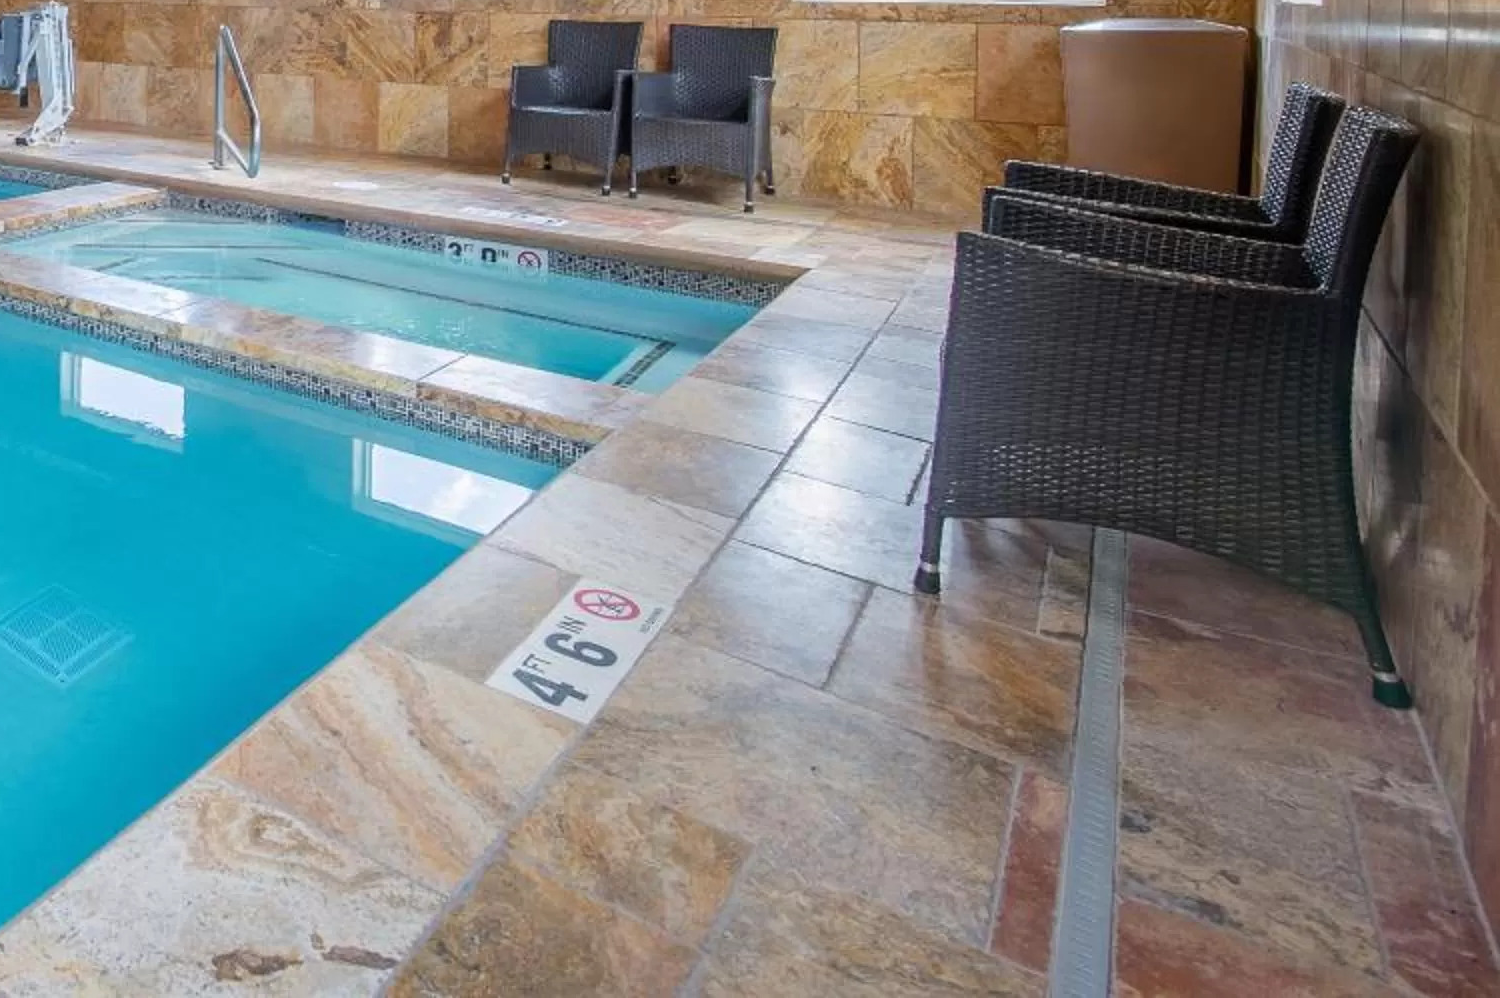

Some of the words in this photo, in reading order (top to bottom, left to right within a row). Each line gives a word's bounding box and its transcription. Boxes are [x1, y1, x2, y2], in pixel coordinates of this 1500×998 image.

[556, 616, 587, 634] IN
[544, 633, 618, 666] 6
[522, 654, 552, 674] FT
[512, 667, 588, 706] 4
